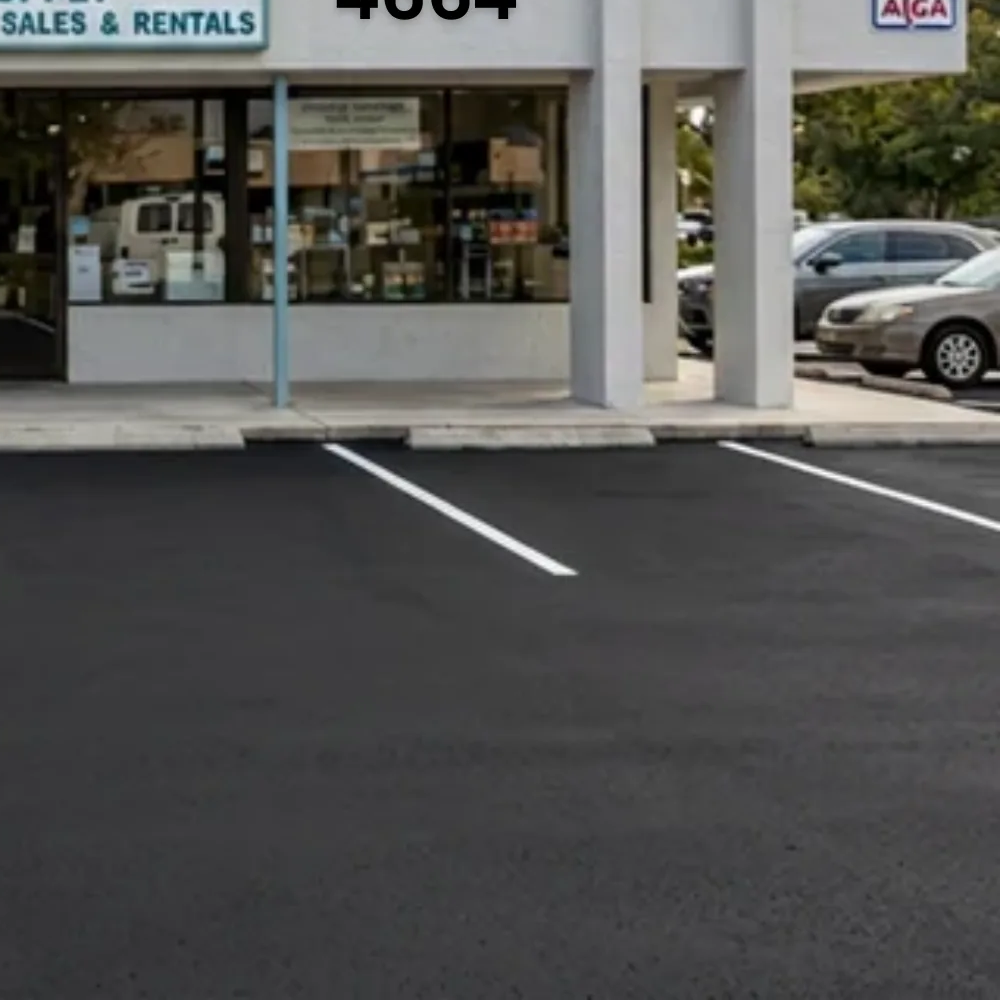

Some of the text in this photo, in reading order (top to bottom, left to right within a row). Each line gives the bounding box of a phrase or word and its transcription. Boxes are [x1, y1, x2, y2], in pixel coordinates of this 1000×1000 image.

[2, 11, 86, 36] SALES
[101, 11, 119, 36] &
[134, 11, 255, 36] RENTALS
